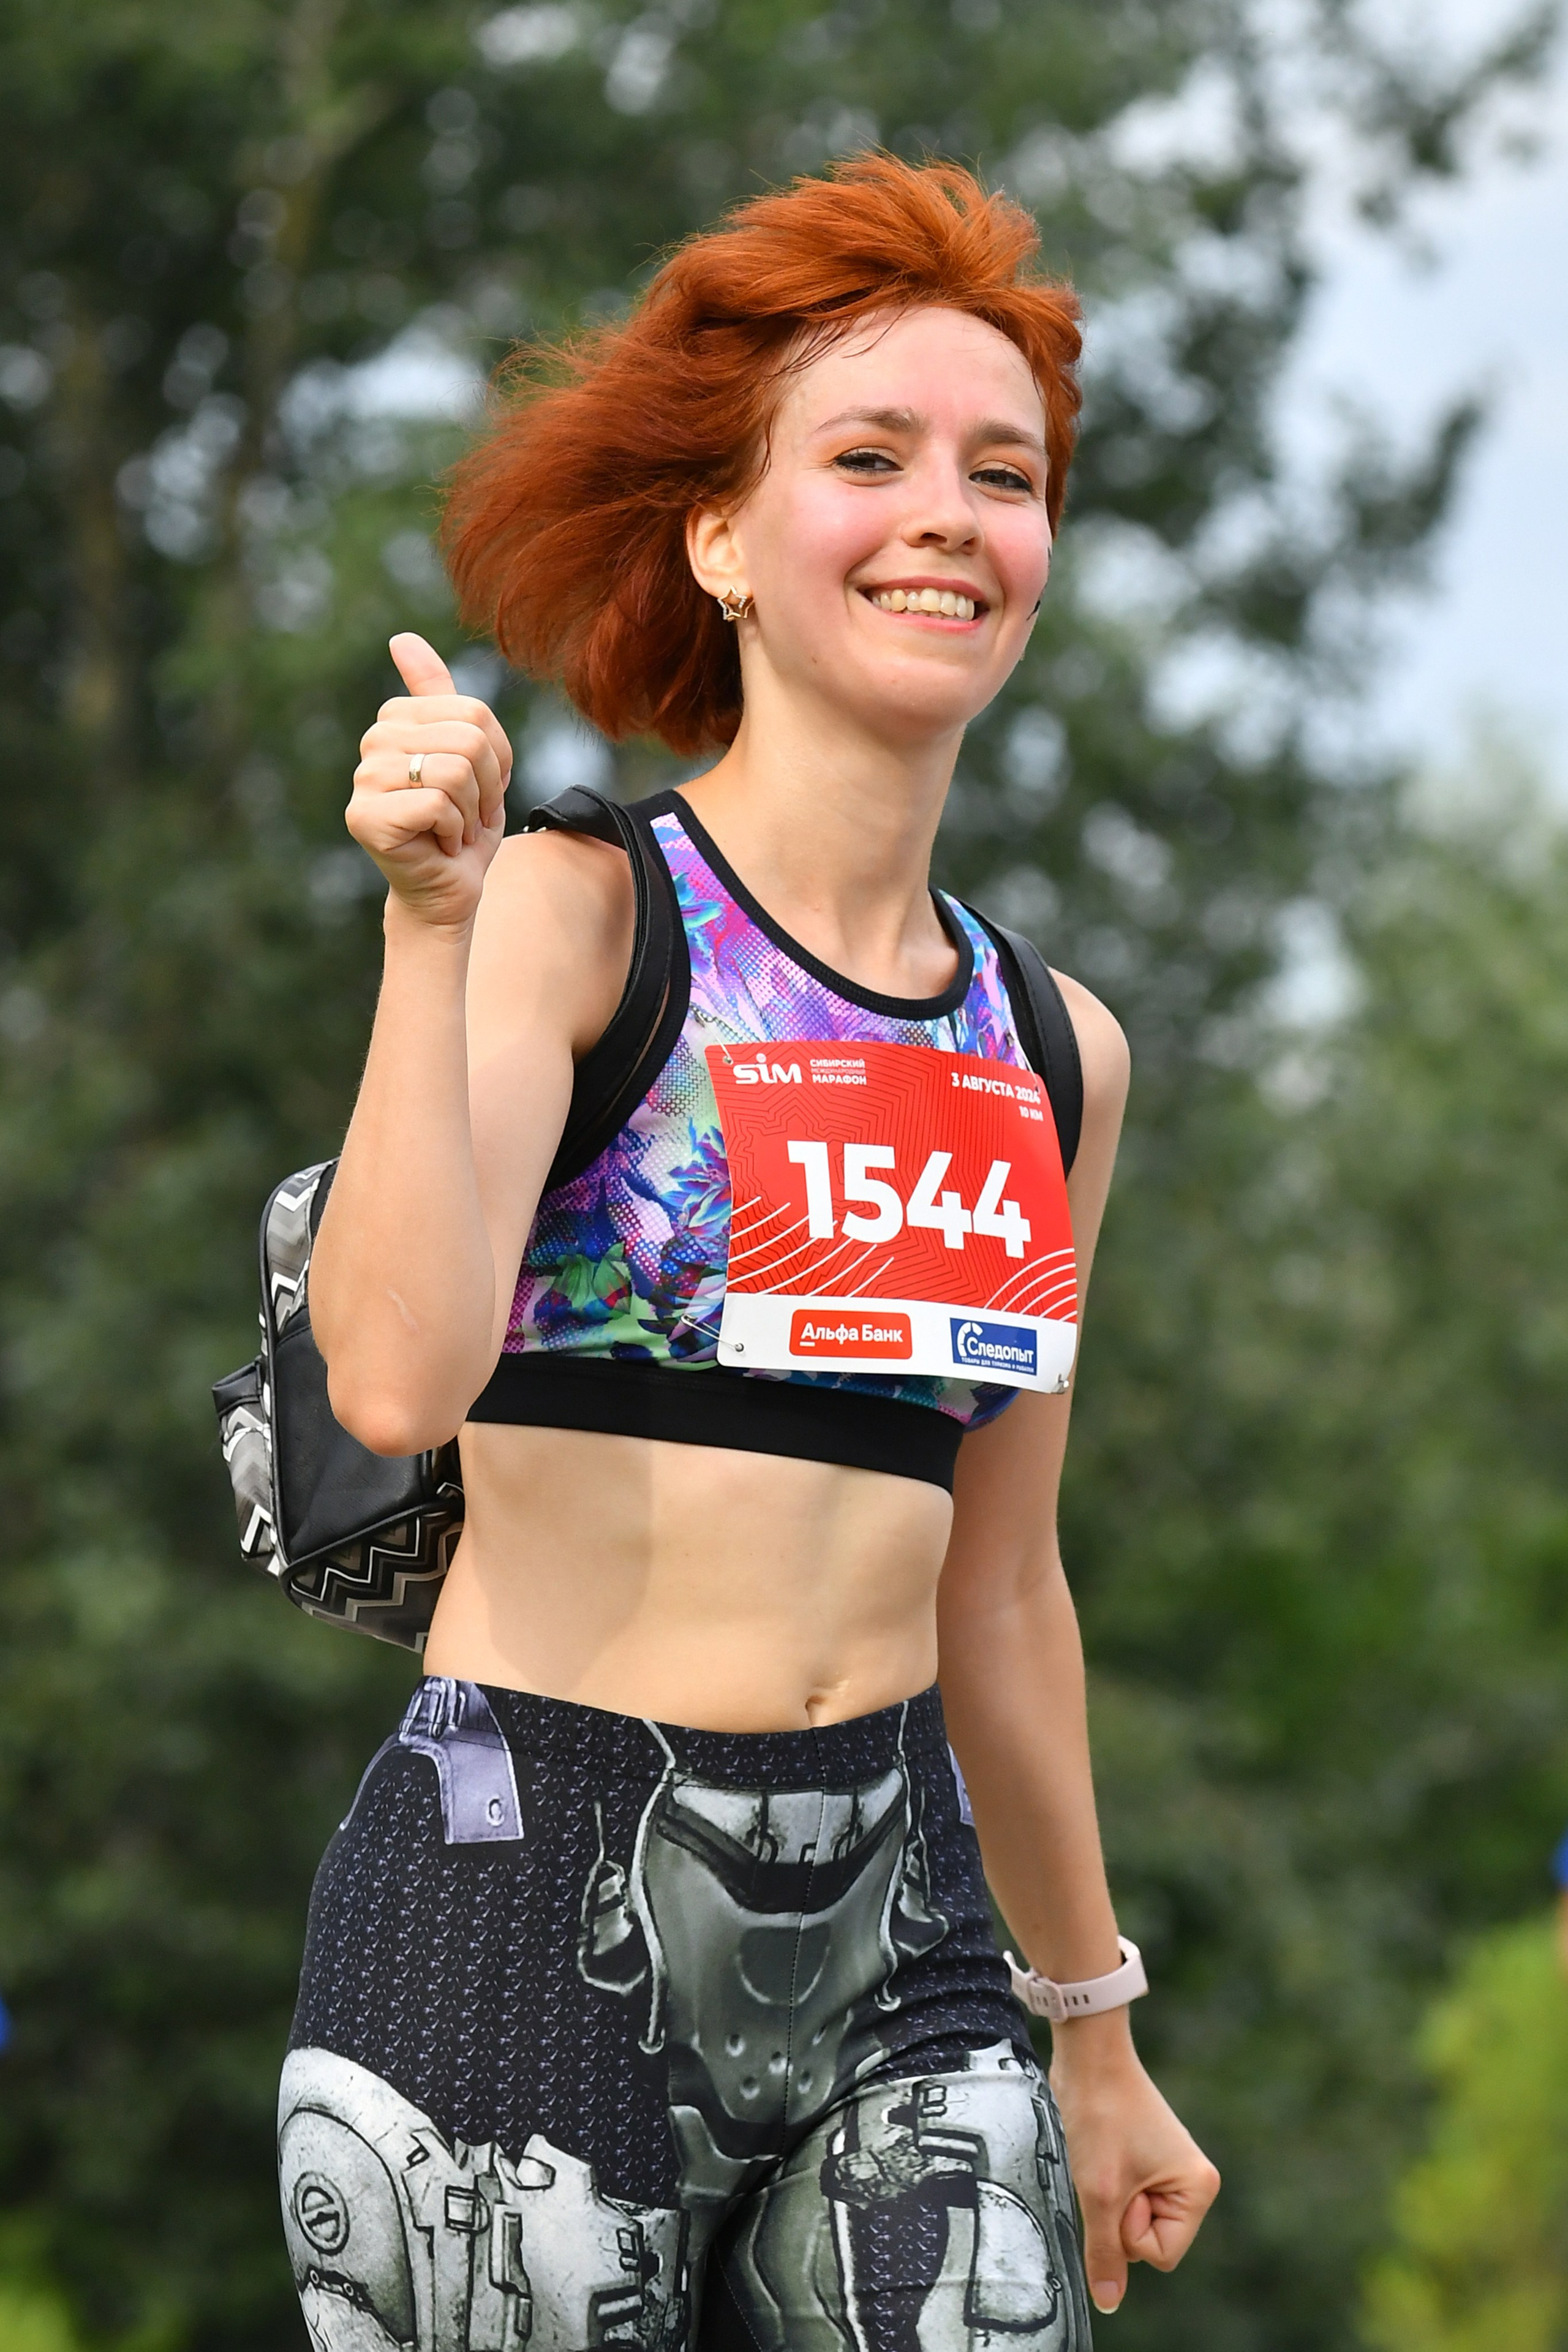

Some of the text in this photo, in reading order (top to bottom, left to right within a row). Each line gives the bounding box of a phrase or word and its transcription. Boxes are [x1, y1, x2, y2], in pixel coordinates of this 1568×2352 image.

[810, 1058, 865, 1068] СИБИРСКИЙ
[812, 1074, 867, 1085] МАРАФОН
[951, 1072, 1041, 1105] 3 АВГУСТА 2024
[1019, 1105, 1029, 1118] 10
[787, 1140, 1032, 1259] 1544
[800, 1322, 903, 1346] Альфа Банк
[967, 1336, 1035, 1363] Следопыт
